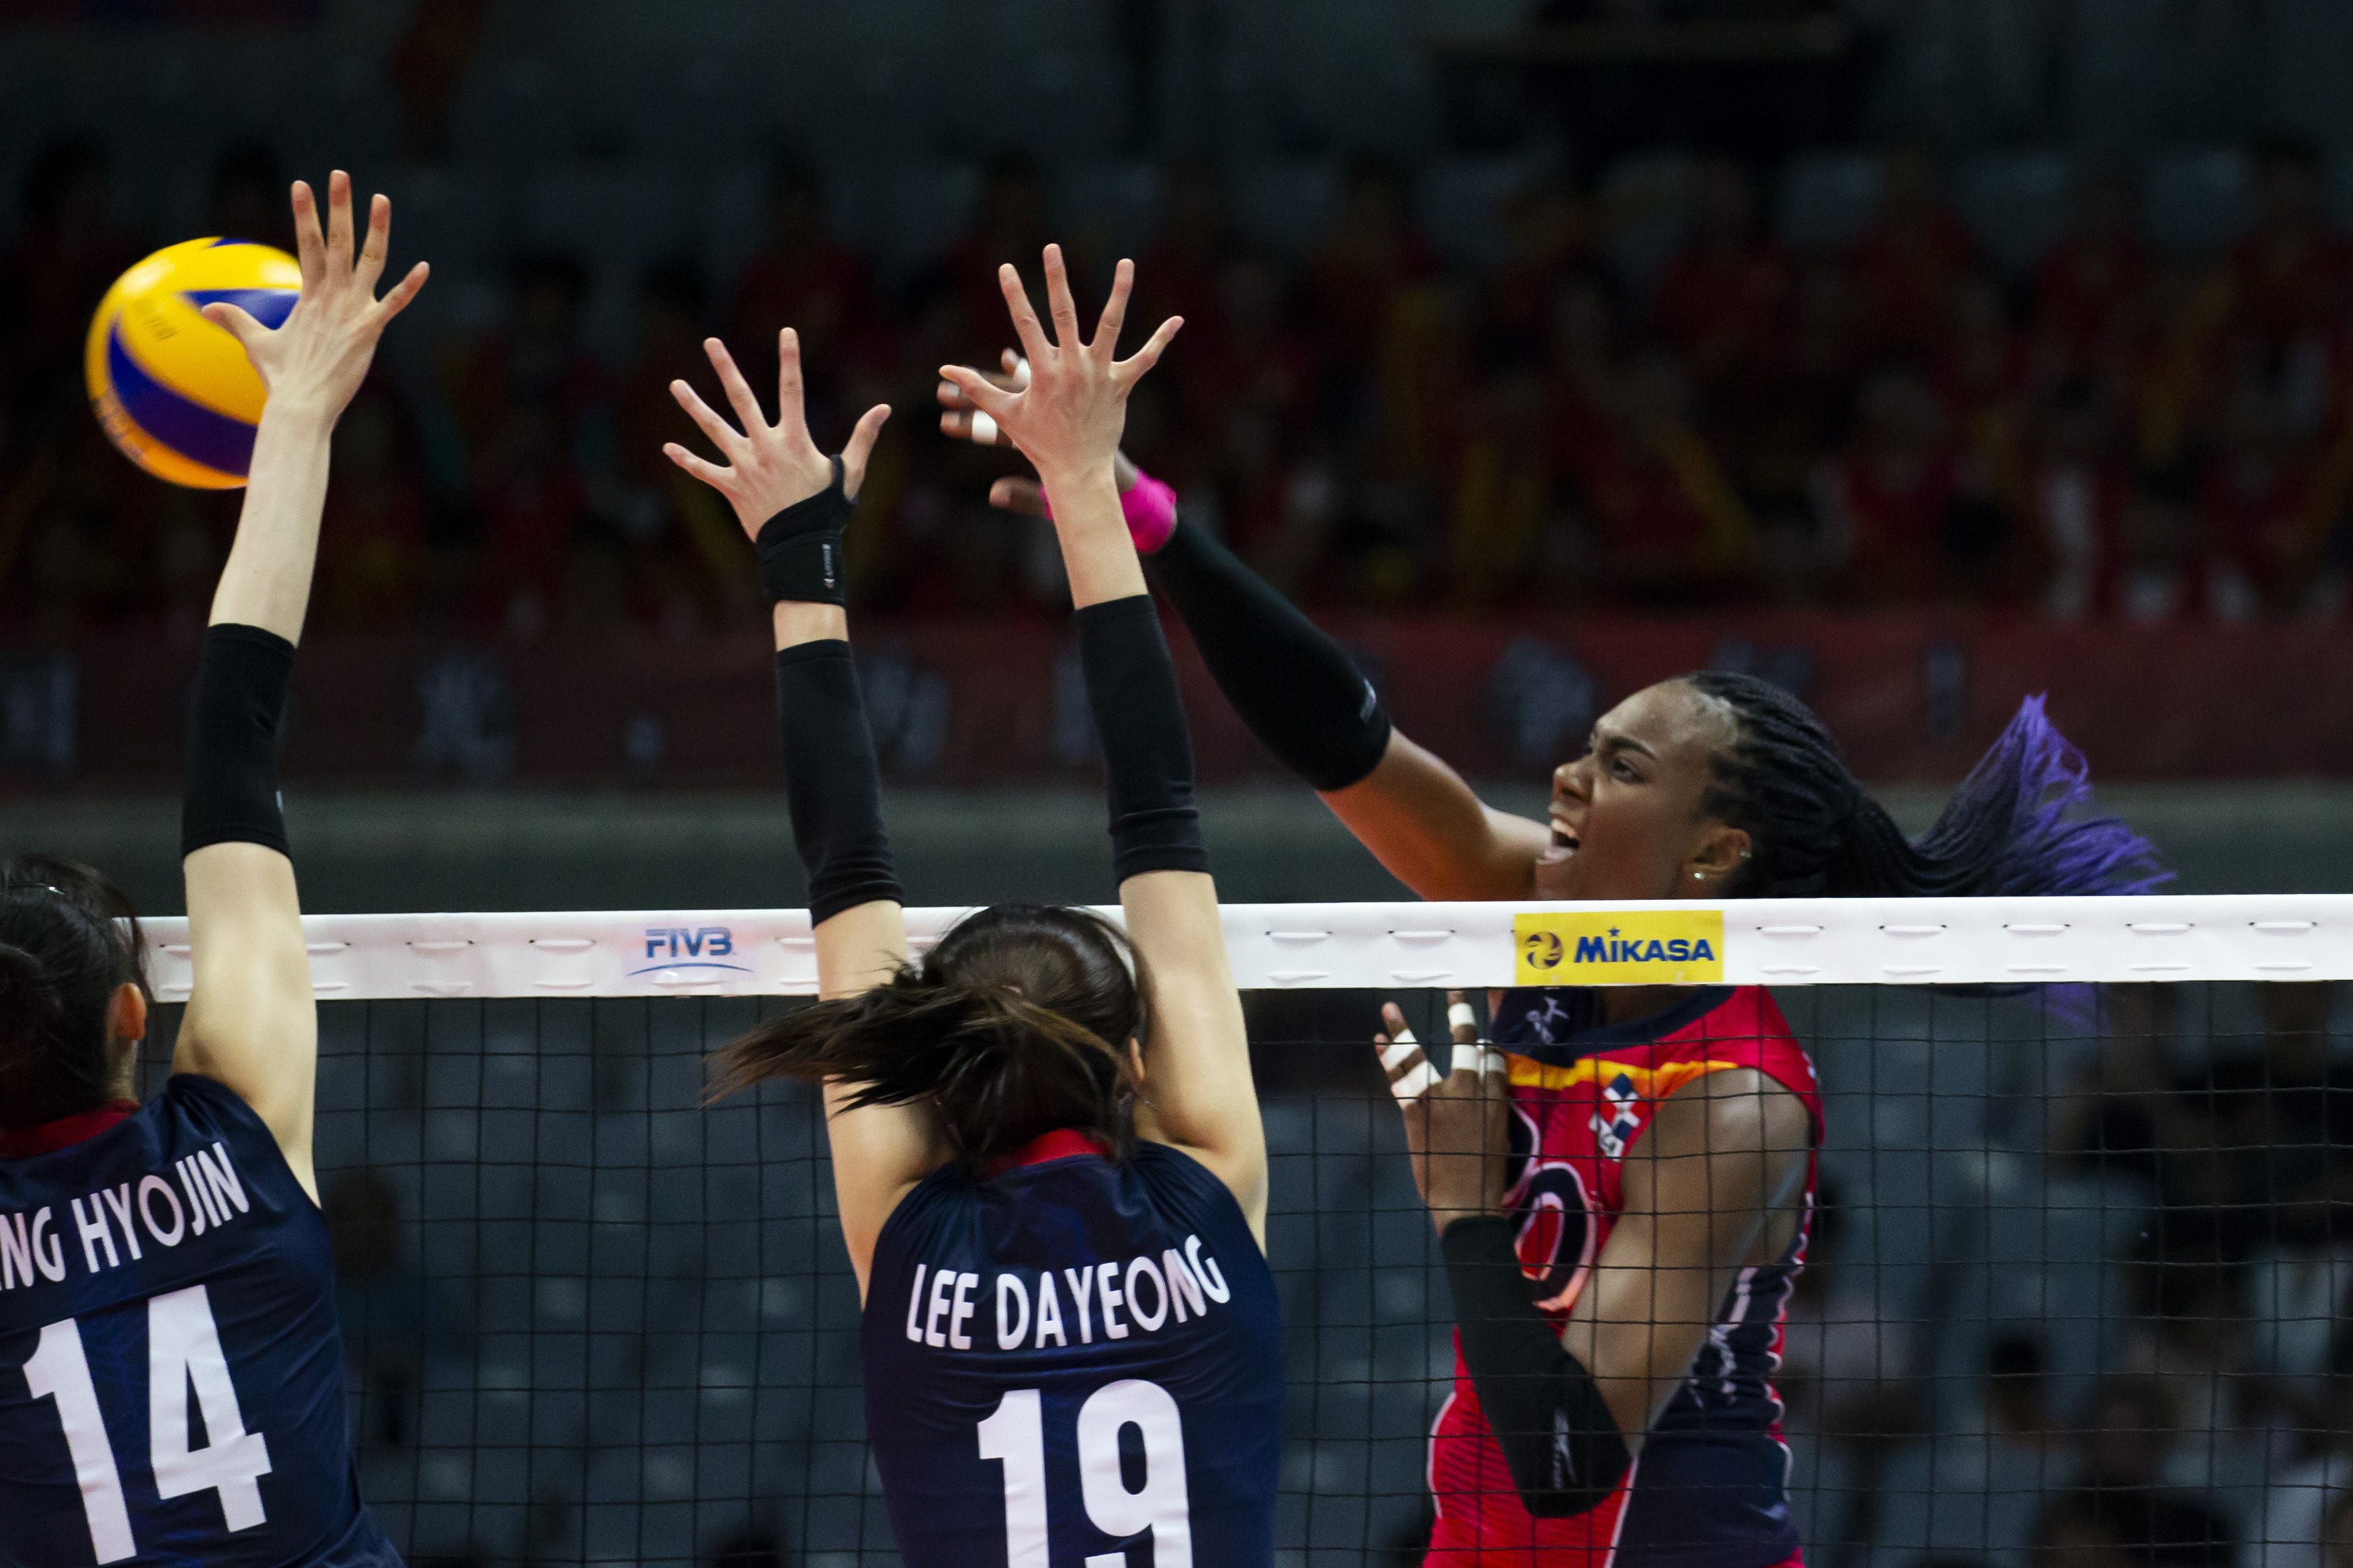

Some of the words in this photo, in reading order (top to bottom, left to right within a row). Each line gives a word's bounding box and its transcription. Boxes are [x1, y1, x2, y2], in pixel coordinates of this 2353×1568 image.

[645, 927, 732, 958] FIVB
[1574, 926, 1714, 962] MIKASA
[0, 1206, 66, 1290] NG
[71, 1141, 249, 1274] HYOJIN
[906, 1264, 979, 1350] LEE
[996, 1235, 1230, 1350] DAYEONG
[22, 1284, 272, 1565] 14
[977, 1379, 1193, 1568] 19
